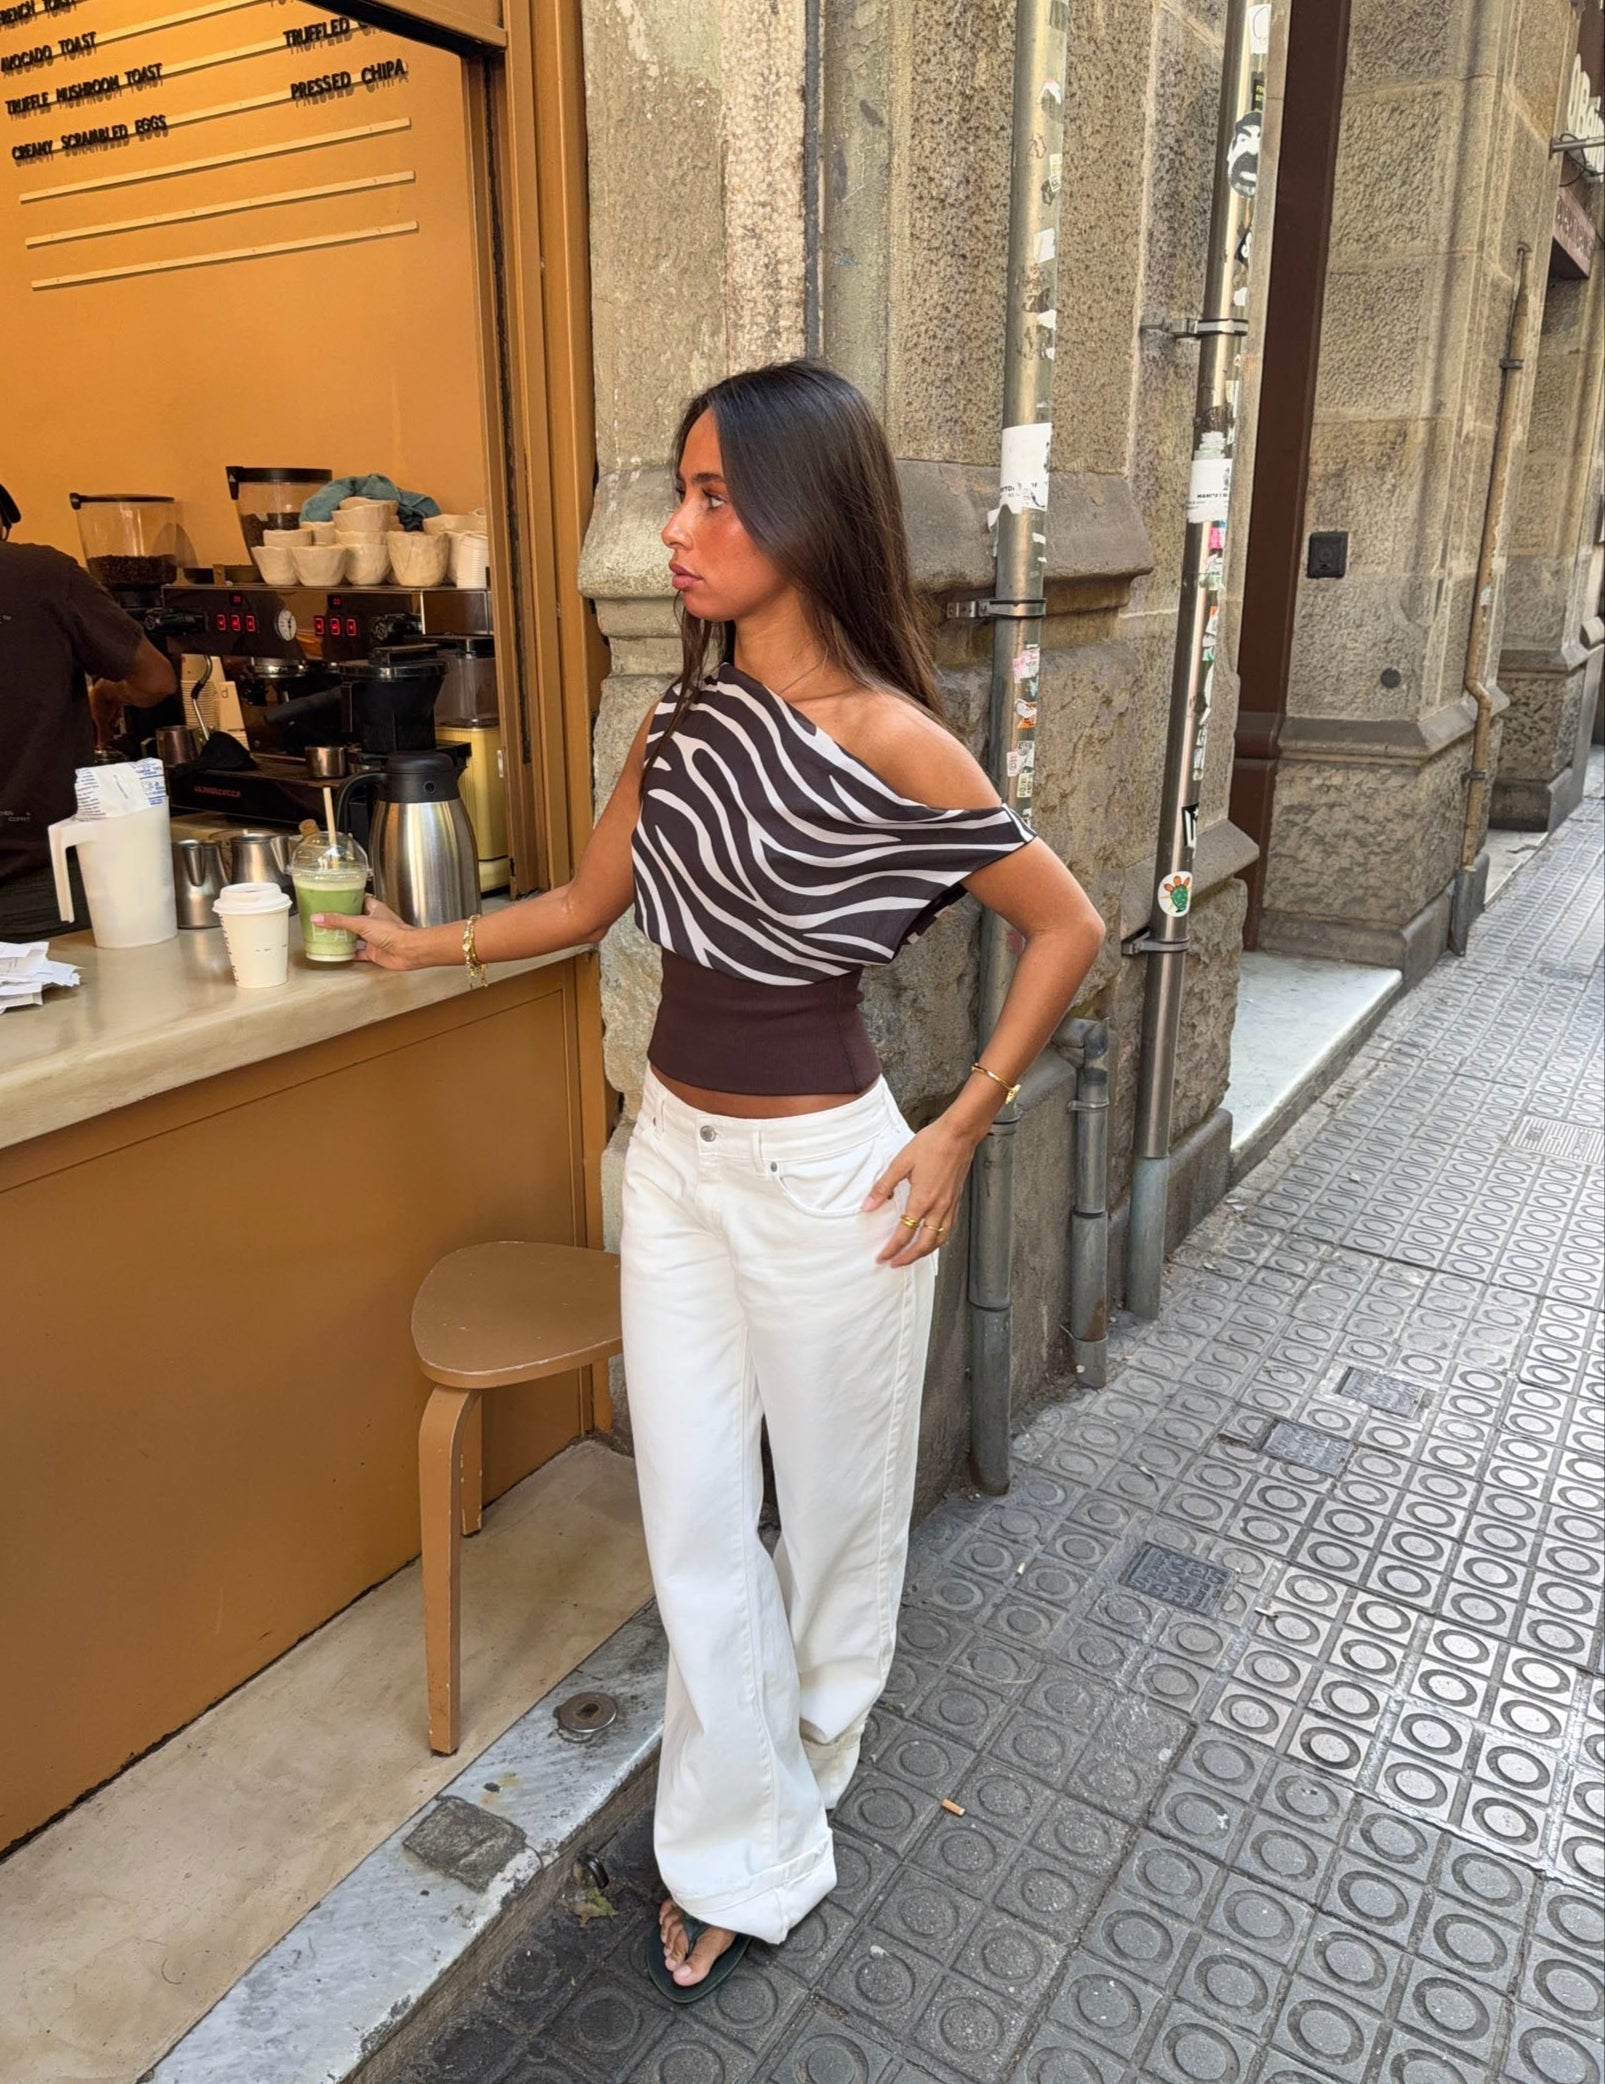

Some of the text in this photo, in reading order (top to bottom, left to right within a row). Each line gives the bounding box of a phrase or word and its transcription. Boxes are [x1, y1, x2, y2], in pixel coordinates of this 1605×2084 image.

[0, 0, 35, 25] RENCH
[283, 17, 350, 47] TRUFFLED
[1, 31, 97, 72] AVOCADO TOAST
[5, 63, 163, 115] TRUFFLE MUSHROOM TOAST
[290, 58, 407, 100] PRESSED CHIPA
[12, 114, 168, 161] CREAMY SCRAMBLED EGGS
